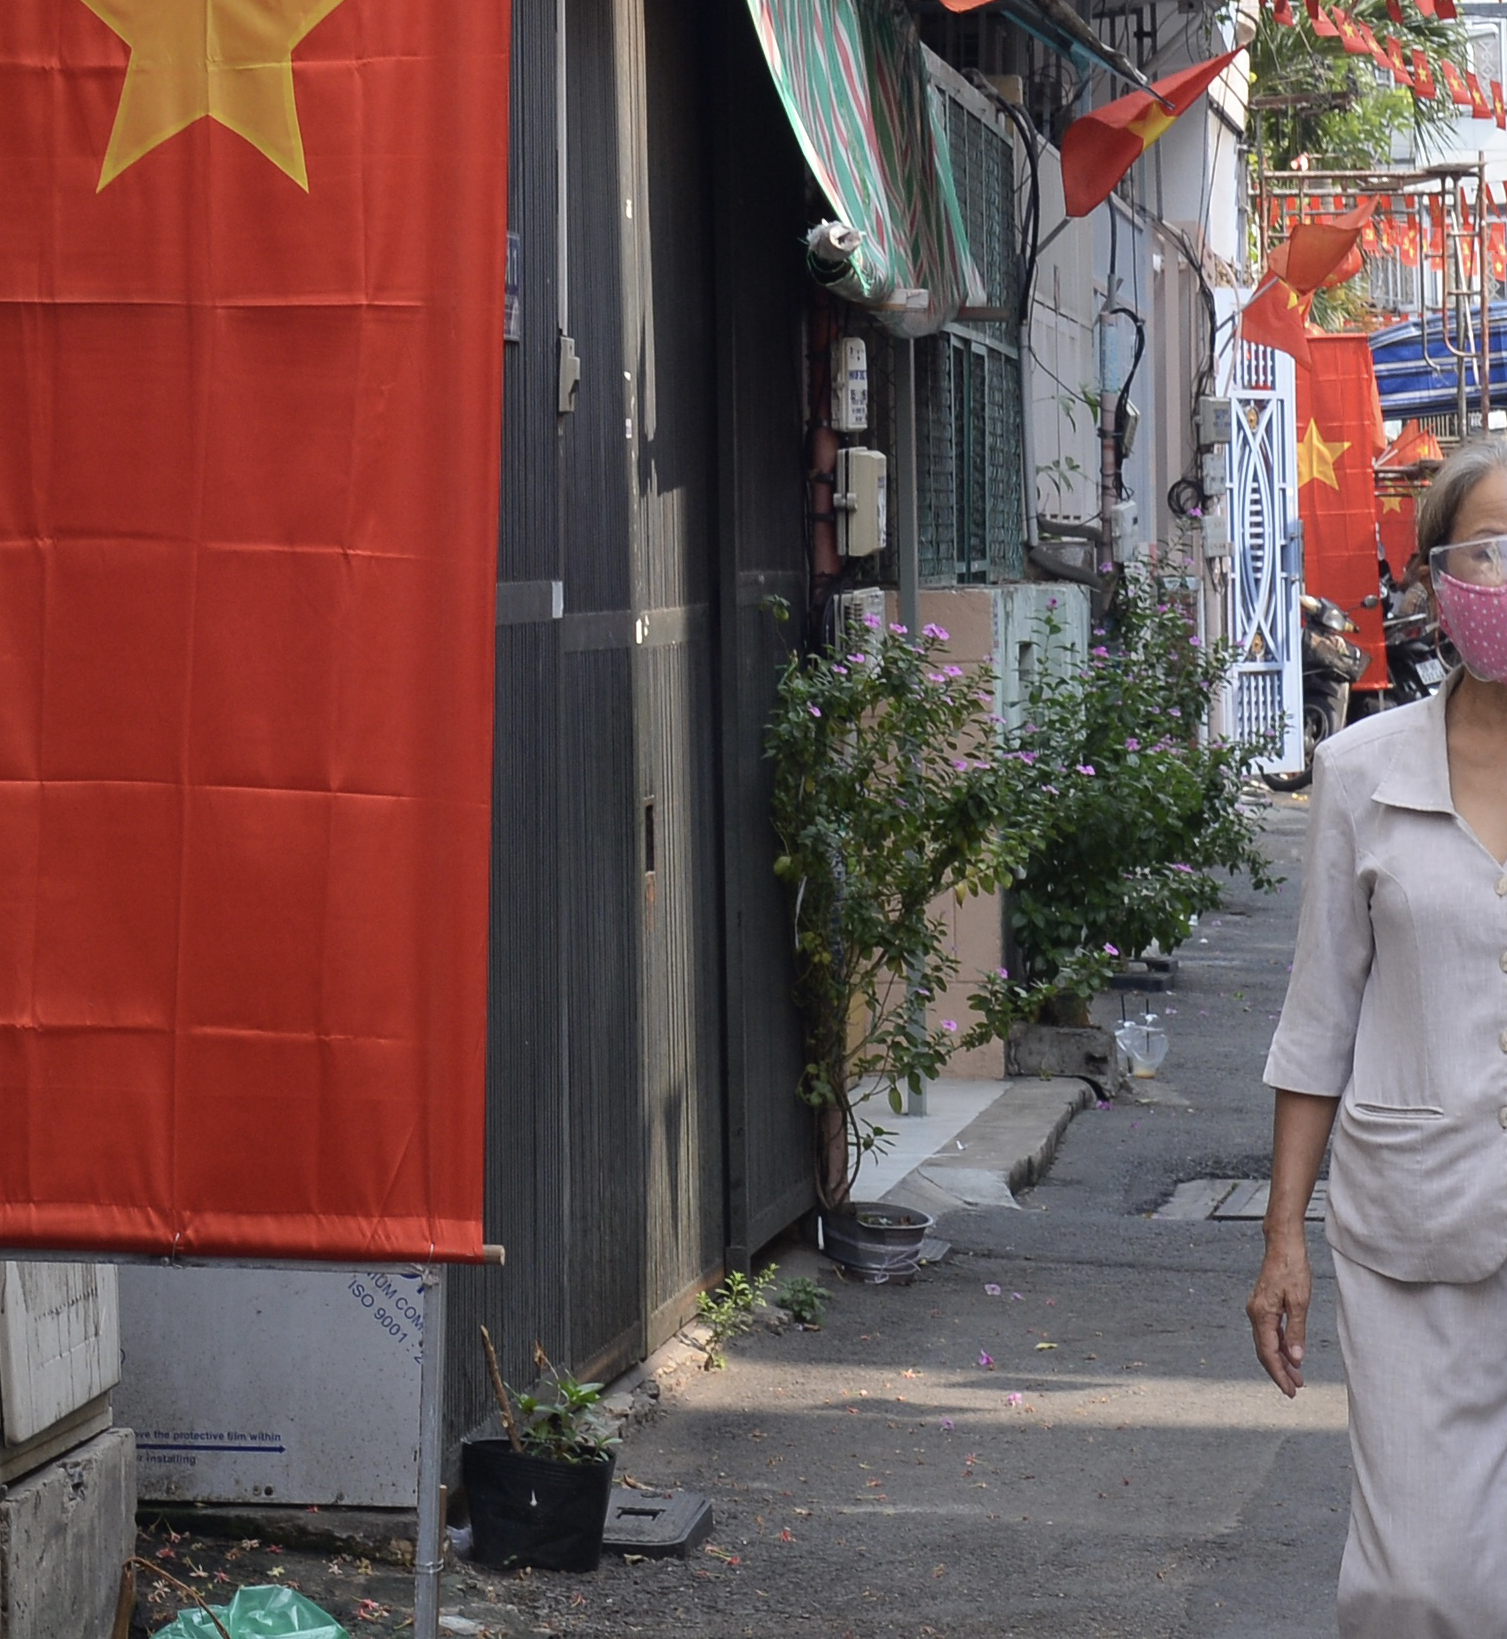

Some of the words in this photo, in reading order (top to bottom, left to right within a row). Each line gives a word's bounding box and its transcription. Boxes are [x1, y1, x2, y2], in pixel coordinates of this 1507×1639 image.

[348, 1279, 375, 1308] ISO
[374, 1307, 408, 1343] 9001
[154, 1430, 170, 1439] the
[173, 1430, 224, 1442] protective
[227, 1432, 247, 1441] film
[249, 1433, 281, 1442] within
[146, 1452, 197, 1466] installing
